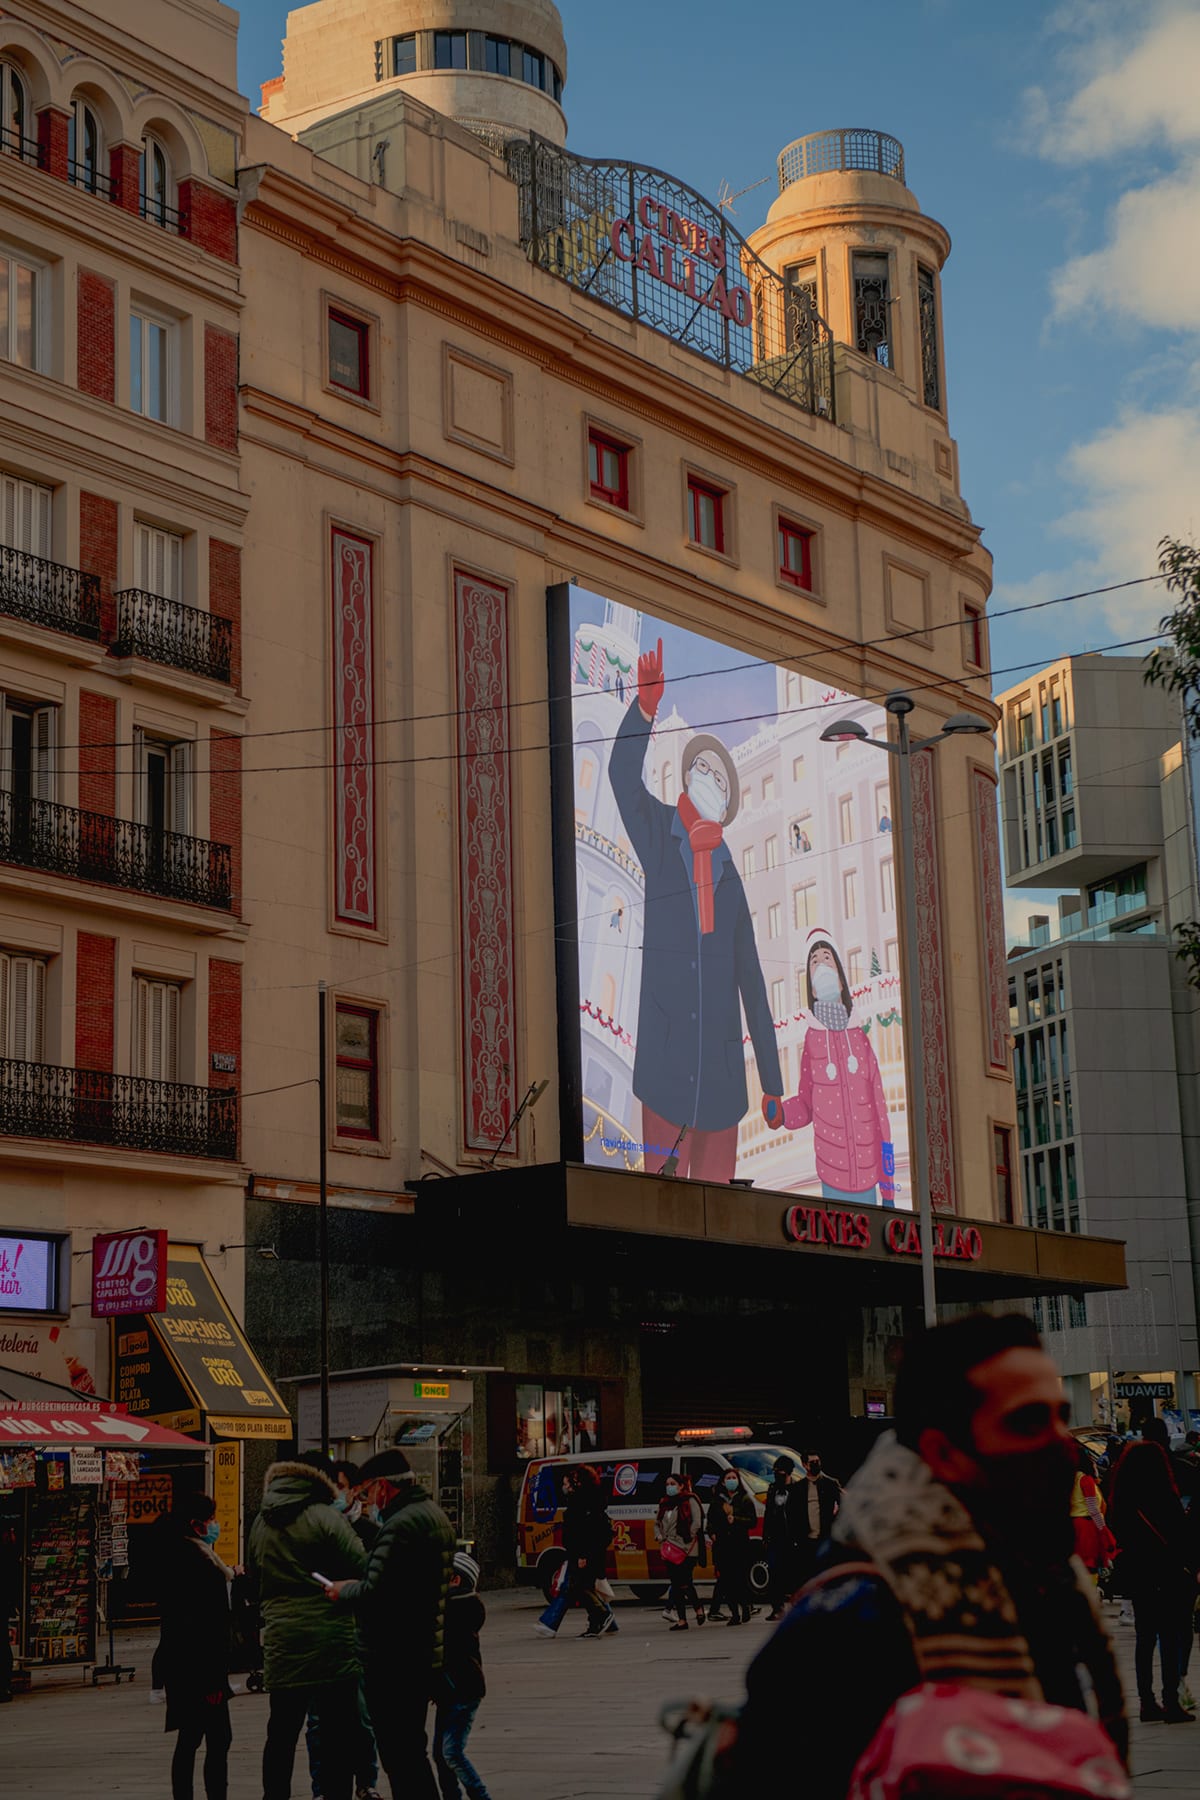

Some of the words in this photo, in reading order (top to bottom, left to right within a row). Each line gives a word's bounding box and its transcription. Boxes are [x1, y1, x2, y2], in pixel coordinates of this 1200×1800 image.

[638, 196, 726, 268] CINES
[611, 218, 753, 327] CALLAO
[785, 1205, 871, 1249] CINES
[885, 1218, 983, 1261] CALAO
[161, 1317, 232, 1340] EMPEÑOS
[120, 1362, 151, 1377] COMPRO
[120, 1377, 135, 1389] ORO
[208, 1367, 244, 1388] ORO
[120, 1387, 142, 1401] PLATA
[424, 1386, 447, 1396] ONCE
[1115, 1384, 1171, 1397] HUAWEI
[50, 1419, 90, 1435] 40
[234, 1423, 246, 1433] ORO
[247, 1423, 263, 1433] PLATA
[264, 1423, 287, 1434] RELOJES
[218, 1453, 236, 1466] ORO
[133, 1495, 168, 1518] gold
